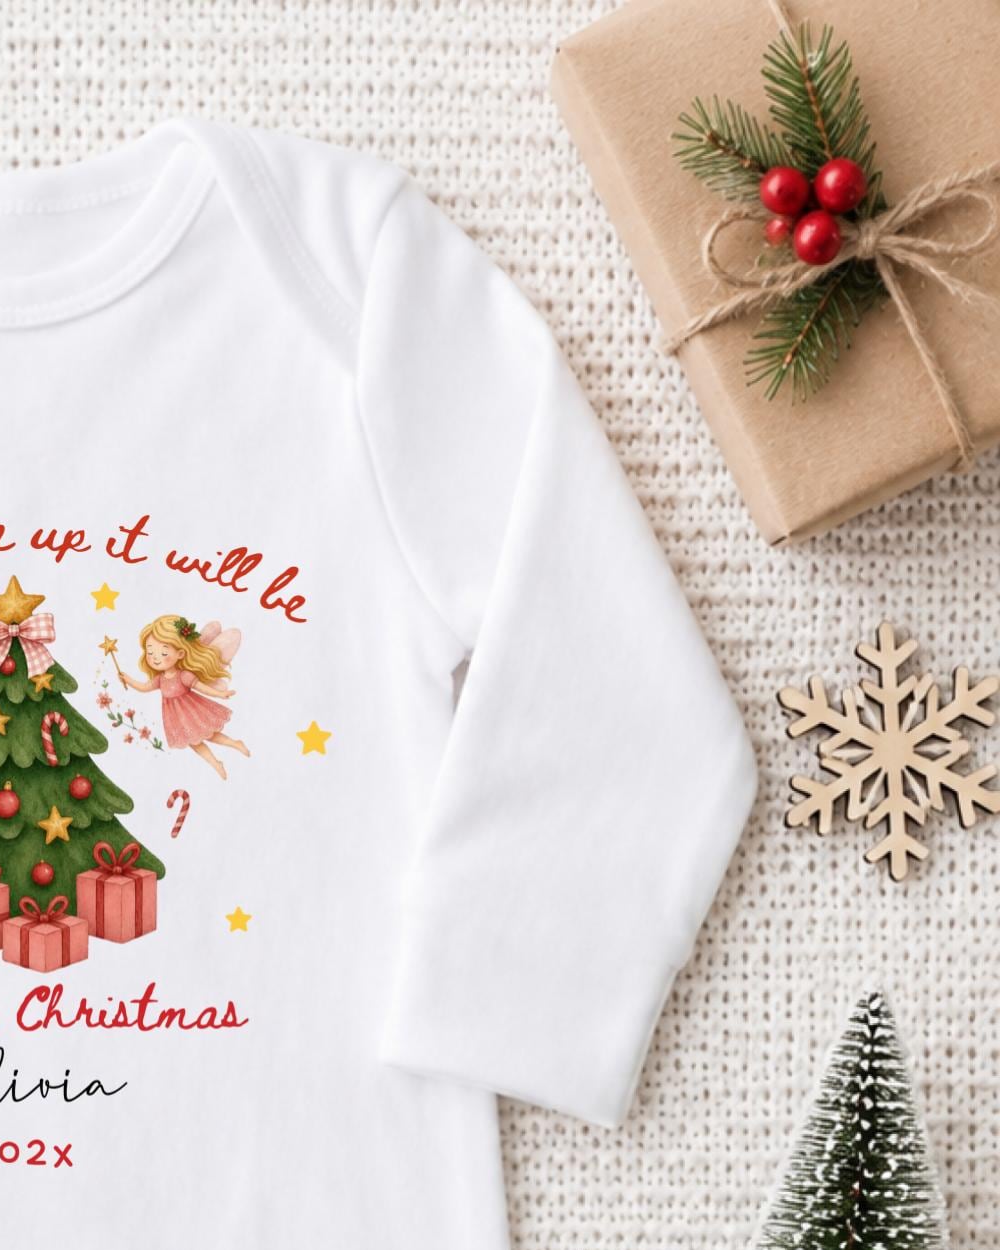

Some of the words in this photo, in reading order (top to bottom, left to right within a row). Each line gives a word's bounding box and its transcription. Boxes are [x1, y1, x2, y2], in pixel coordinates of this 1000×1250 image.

[30, 528, 91, 563] up
[105, 514, 150, 563] it
[166, 546, 264, 593] will
[260, 566, 307, 623] be
[16, 982, 249, 1032] Christmas
